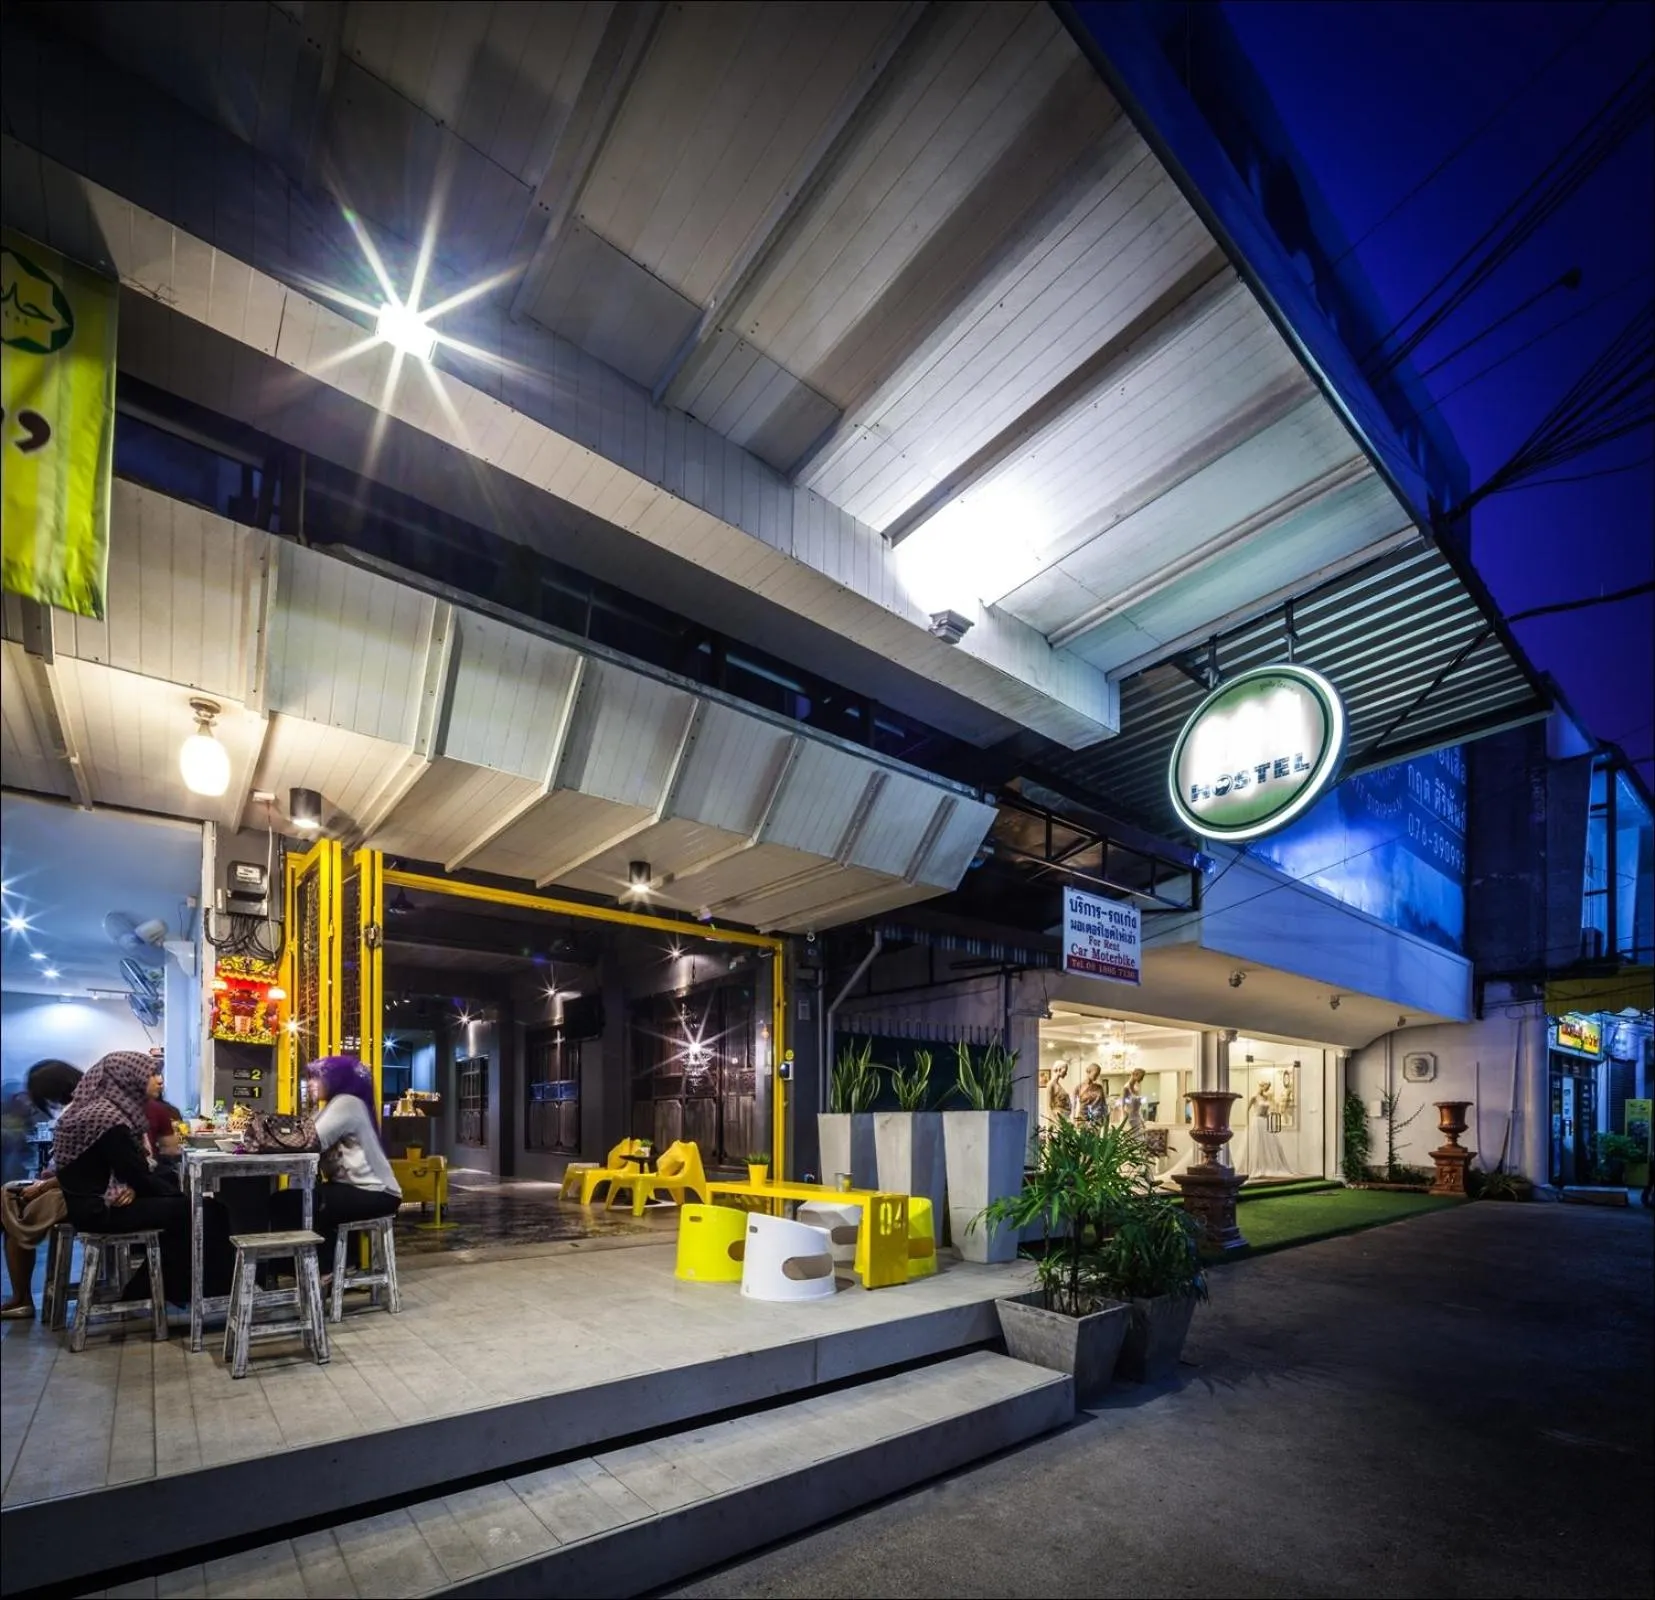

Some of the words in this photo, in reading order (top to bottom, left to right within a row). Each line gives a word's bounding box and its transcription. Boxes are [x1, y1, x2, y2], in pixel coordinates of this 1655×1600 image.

[1191, 752, 1310, 803] HOSTEL
[1071, 942, 1088, 957] Car
[1088, 935, 1101, 947] For
[1104, 939, 1120, 951] Rent
[251, 1068, 261, 1080] 2
[253, 1086, 259, 1098] 1
[880, 1201, 906, 1236] 04
